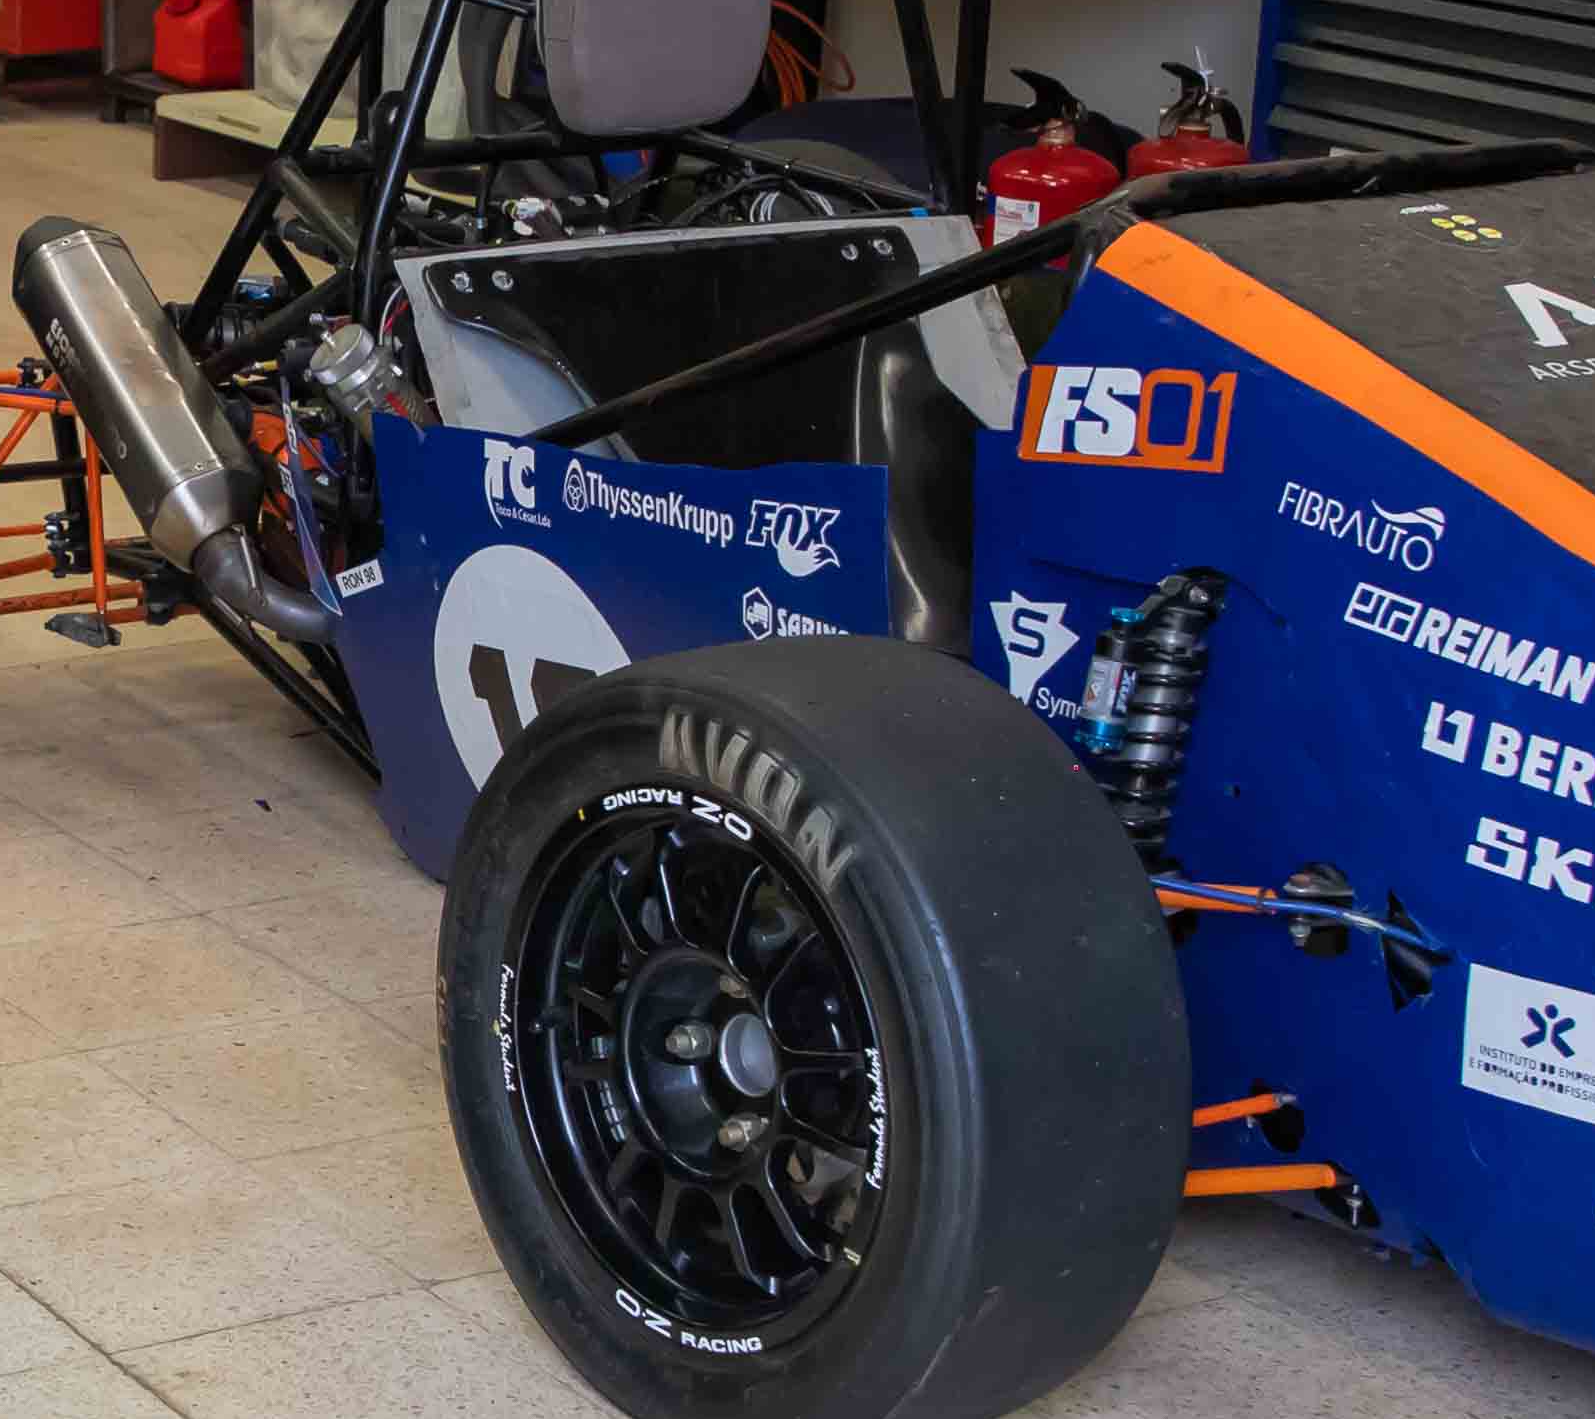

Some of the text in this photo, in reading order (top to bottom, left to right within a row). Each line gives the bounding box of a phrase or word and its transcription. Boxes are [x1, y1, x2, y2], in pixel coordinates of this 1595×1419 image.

[586, 470, 735, 549] ThyssenKrupp
[745, 499, 842, 567] FOX
[1277, 481, 1436, 572] FIBRAUTO
[601, 787, 683, 812] RACING
[680, 1331, 764, 1355] RACING
